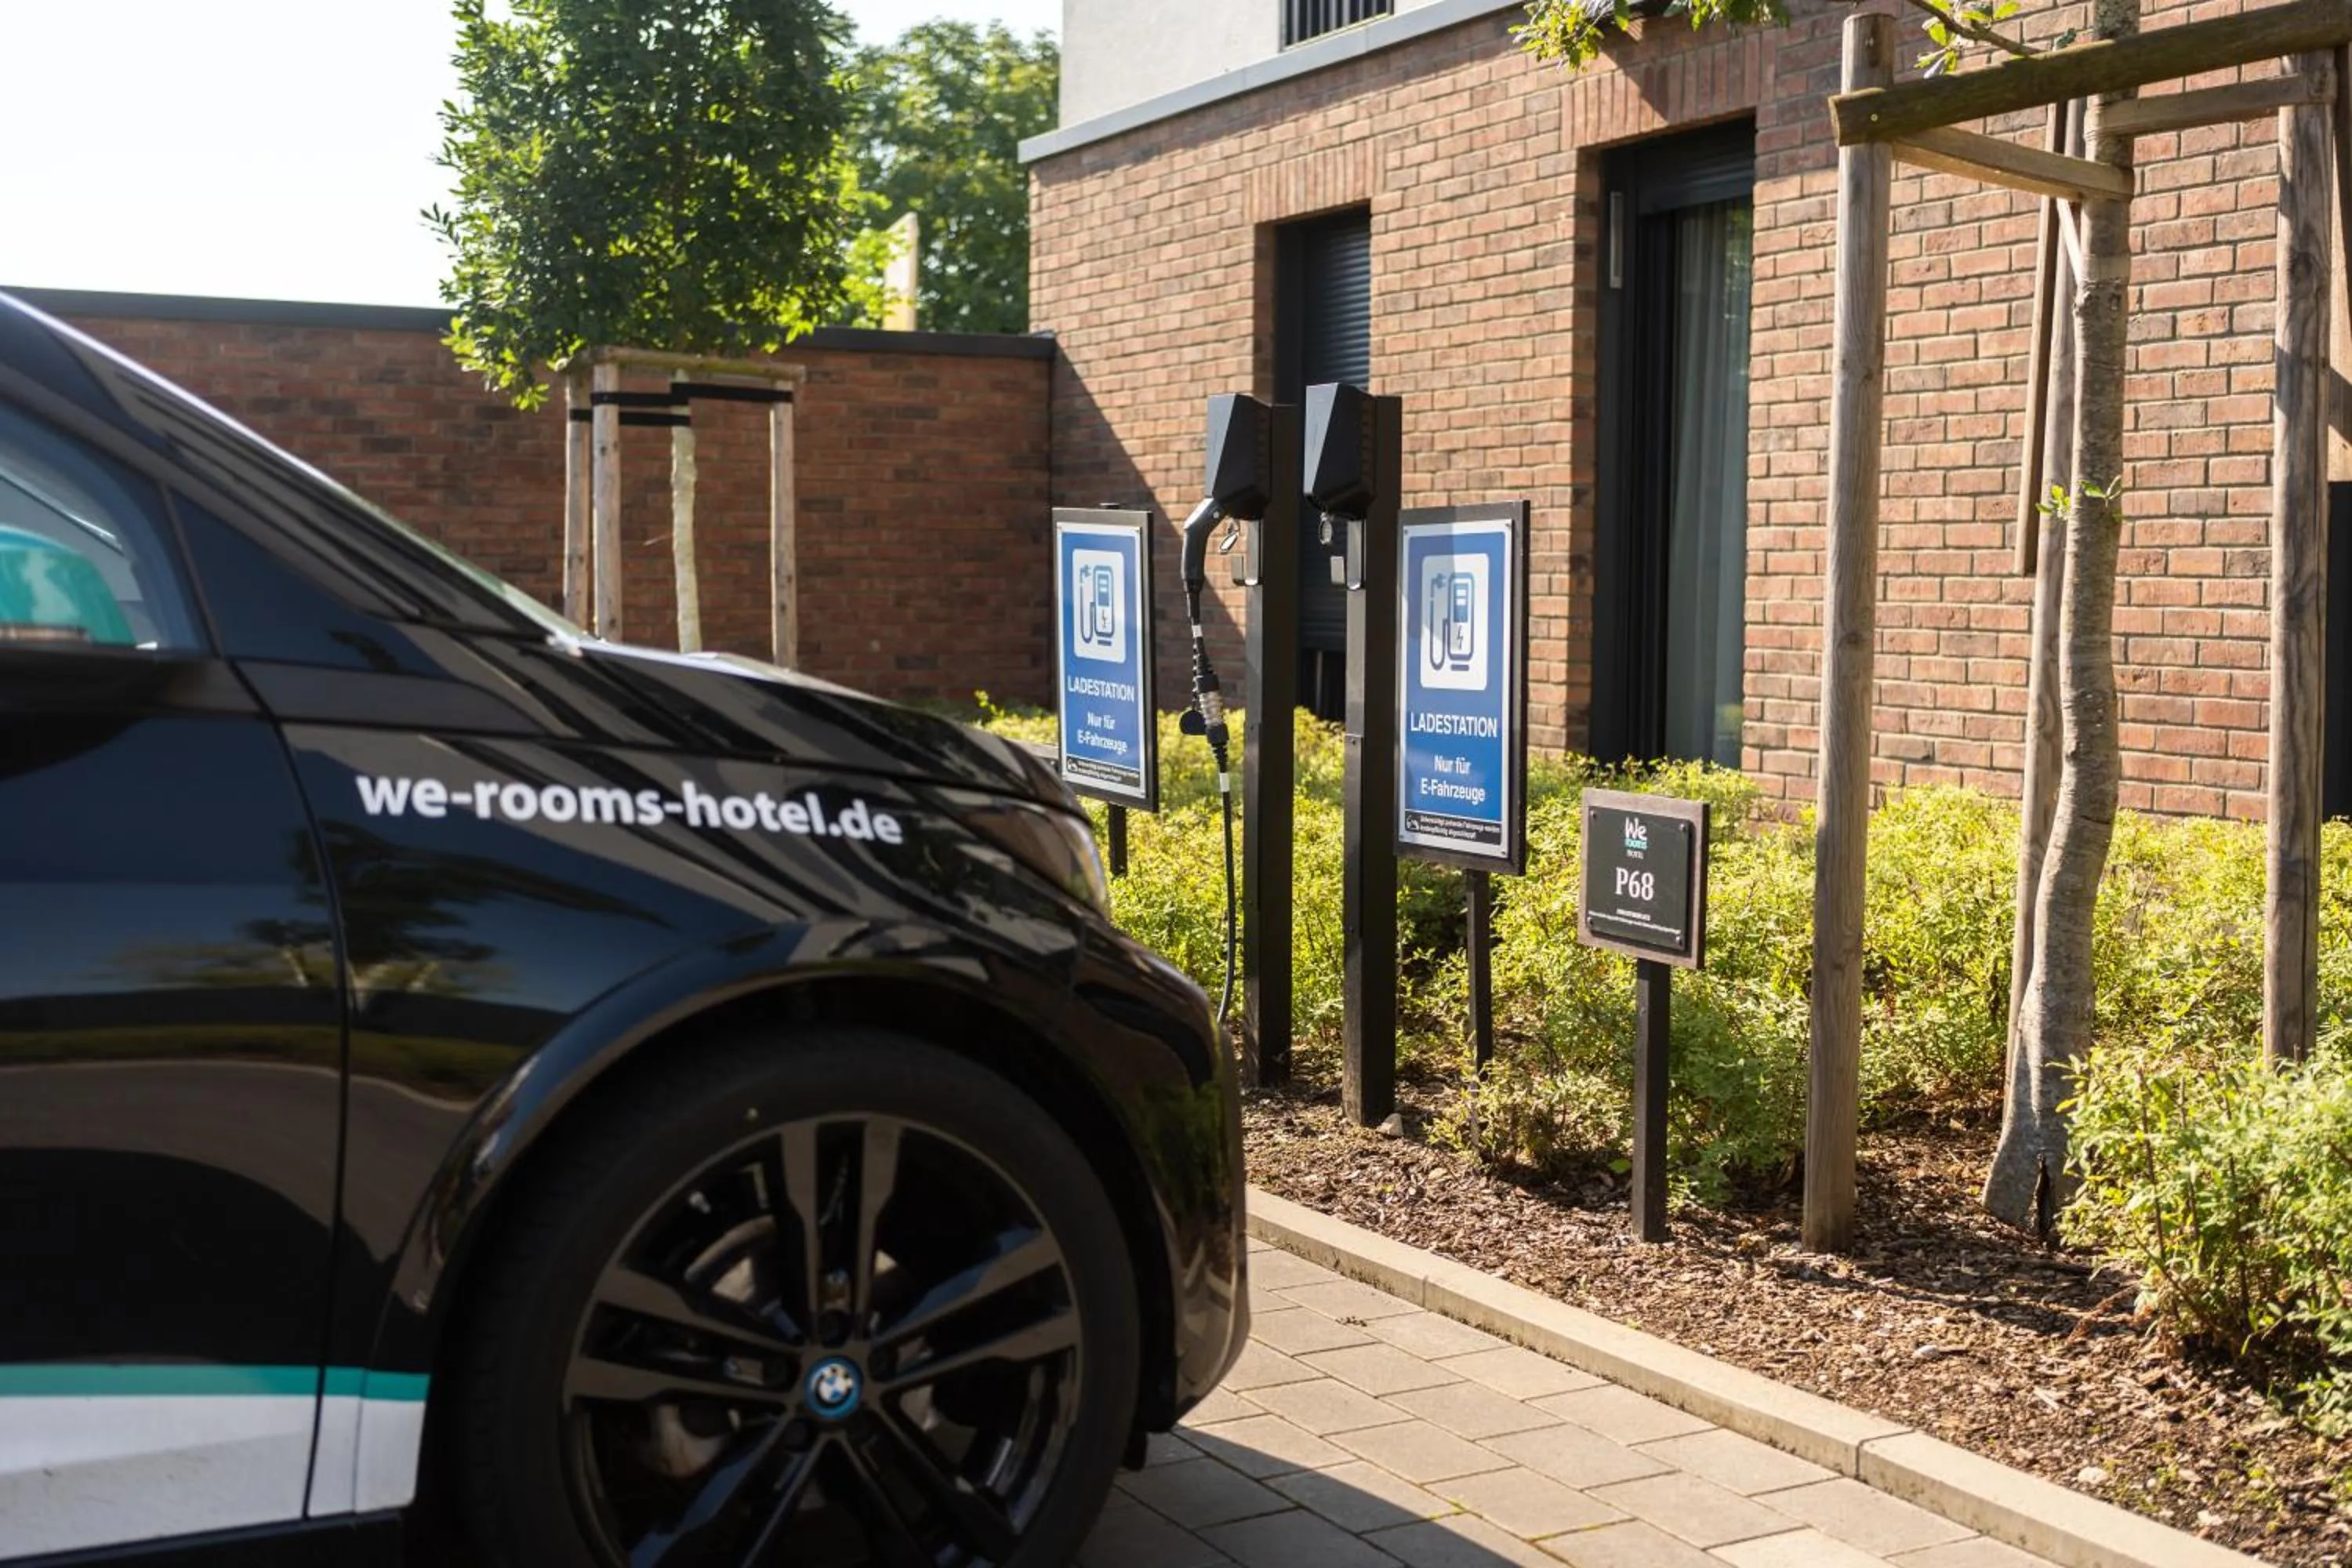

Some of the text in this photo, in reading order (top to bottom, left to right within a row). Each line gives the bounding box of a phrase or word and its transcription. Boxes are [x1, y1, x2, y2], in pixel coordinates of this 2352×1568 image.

[1068, 675, 1134, 702] LADESTATION
[1087, 711, 1116, 729] Nur für
[1410, 712, 1497, 737] LADESTATION
[1077, 729, 1127, 755] E-Fahrzeuge
[1434, 755, 1471, 774] Nur für
[1421, 778, 1486, 804] E-Fahrzeuge
[355, 775, 903, 844] we-rooms-hotel.de
[1624, 817, 1647, 840] We
[1615, 866, 1654, 901] P68
